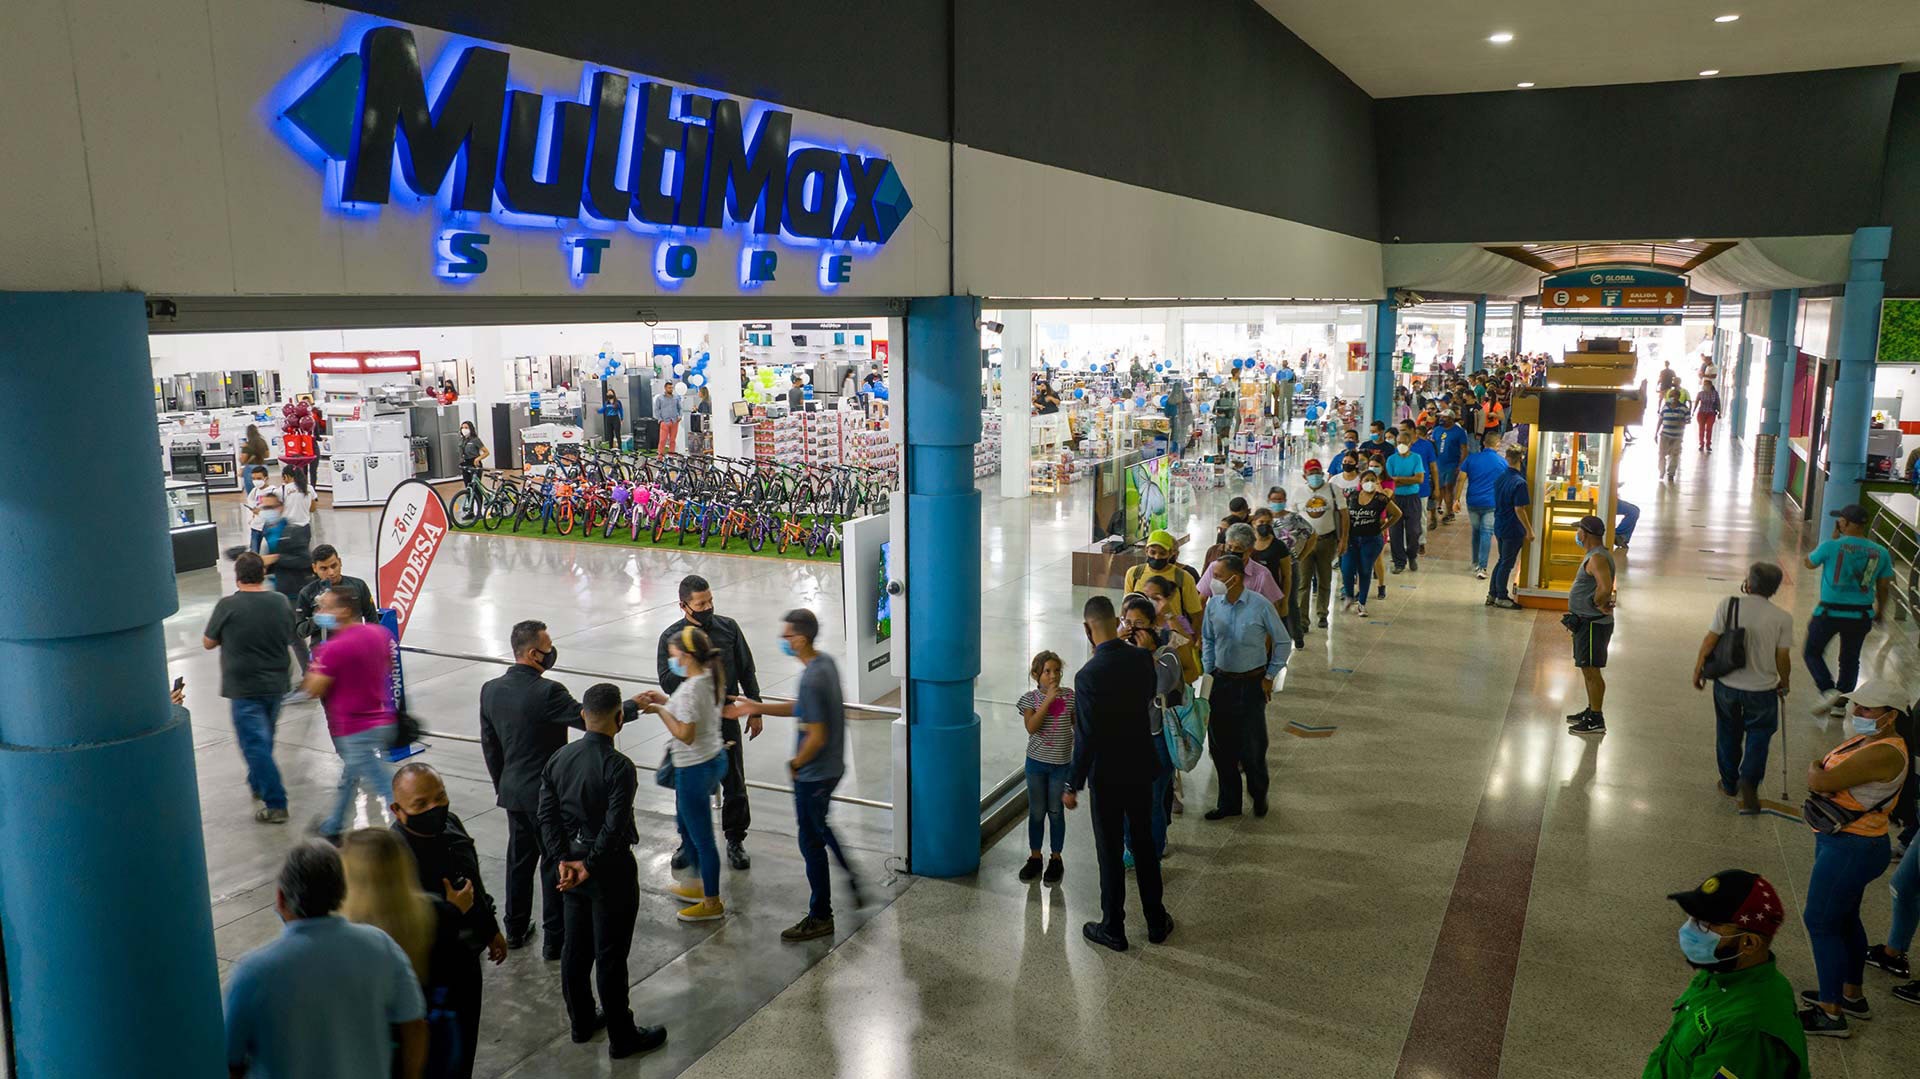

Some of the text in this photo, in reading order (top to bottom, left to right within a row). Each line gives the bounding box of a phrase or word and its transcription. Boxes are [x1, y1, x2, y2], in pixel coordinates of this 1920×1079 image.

[344, 26, 889, 243] MultiMax
[446, 232, 852, 284] STORE
[1557, 293, 1566, 303] E
[1606, 296, 1616, 306] F
[389, 521, 443, 625] ONDESA
